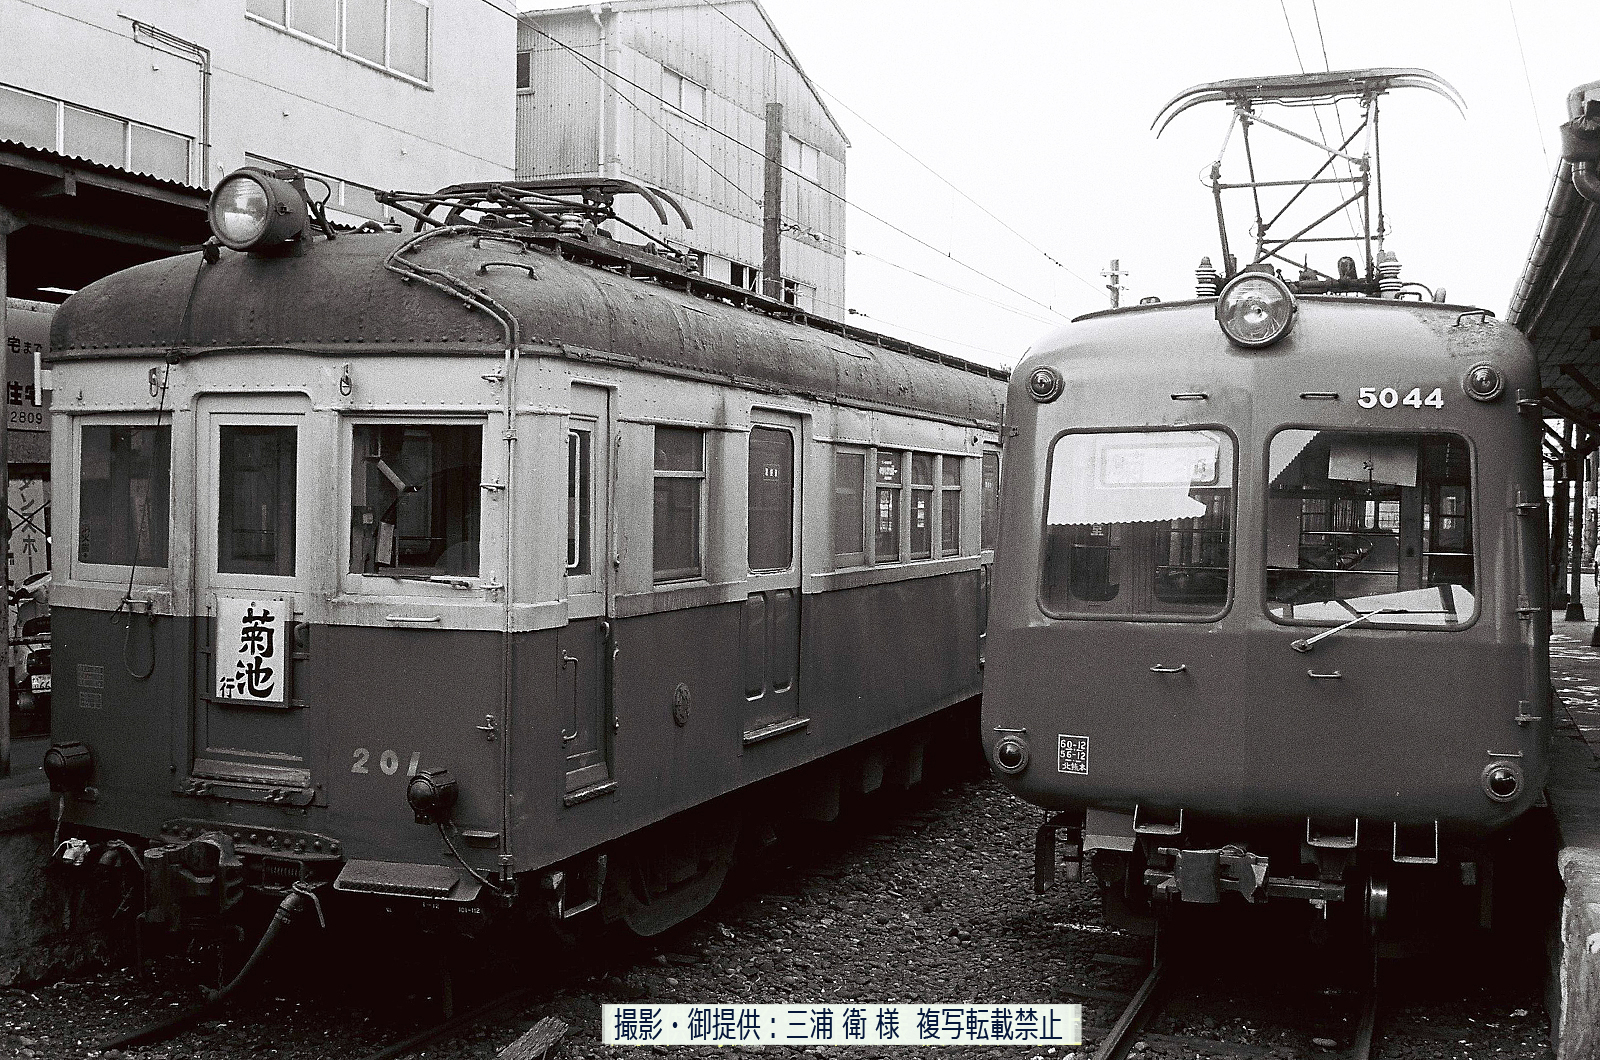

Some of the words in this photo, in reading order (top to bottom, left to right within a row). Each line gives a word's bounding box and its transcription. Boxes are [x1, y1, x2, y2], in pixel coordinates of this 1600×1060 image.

[1357, 387, 1444, 409] 5044
[10, 411, 43, 425] 2809
[235, 607, 276, 698] 菊池
[219, 676, 236, 699] 行
[350, 747, 421, 777] 201
